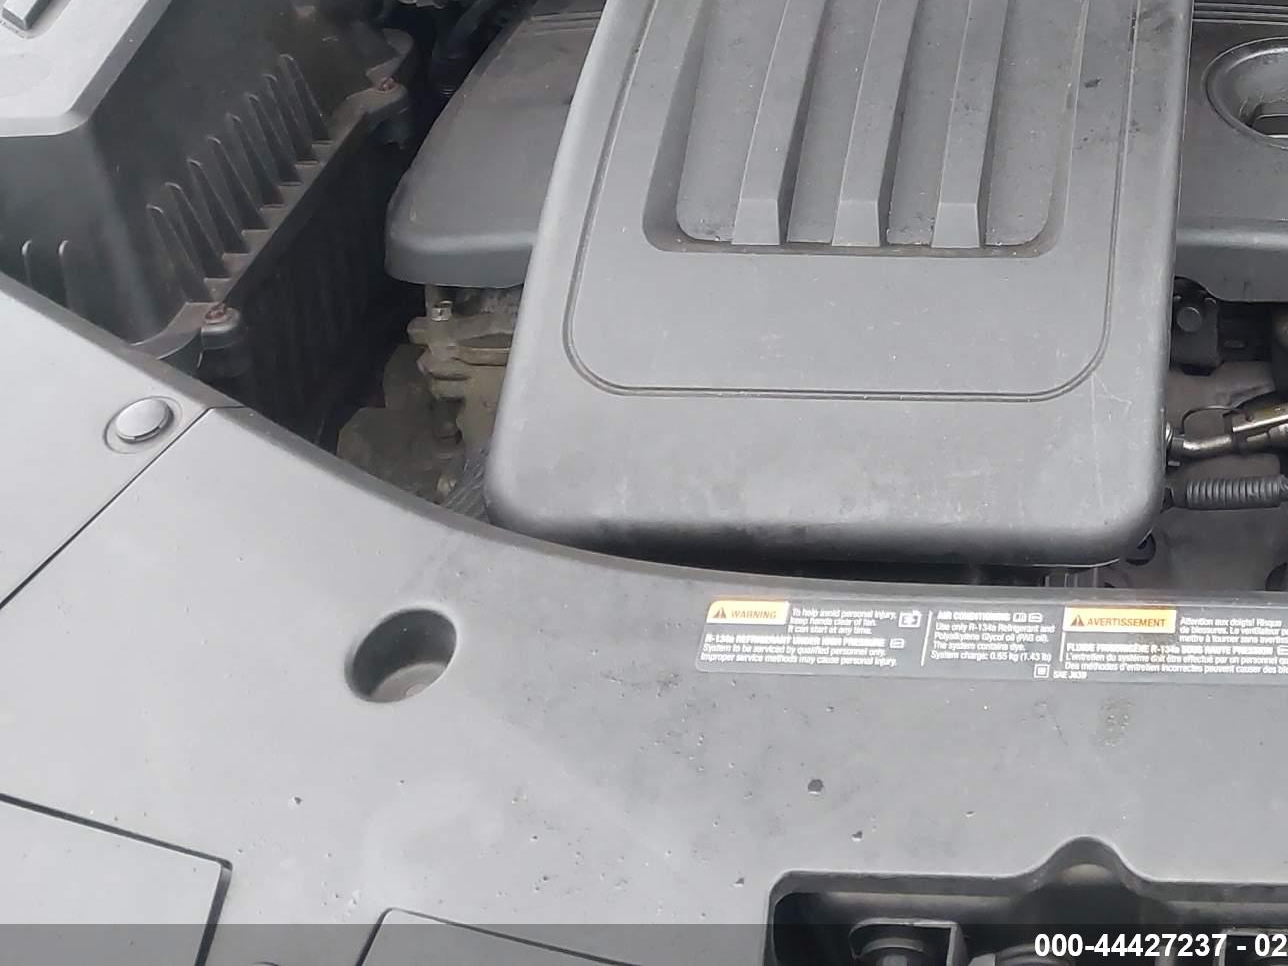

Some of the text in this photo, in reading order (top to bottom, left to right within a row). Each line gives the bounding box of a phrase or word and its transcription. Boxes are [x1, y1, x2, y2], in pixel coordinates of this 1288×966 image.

[731, 610, 777, 619] WARNING
[802, 608, 818, 618] help
[841, 610, 873, 619] personal
[1088, 618, 1167, 627] AVERTISSEMENT
[1180, 617, 1213, 626] Attention
[810, 626, 827, 634] start
[828, 626, 837, 634] at
[838, 627, 852, 636] any
[936, 622, 950, 631] Use
[952, 623, 967, 632] only
[969, 624, 996, 632] R-134a
[1240, 628, 1280, 636] ventilateur
[982, 633, 1004, 642] Glycol
[1006, 634, 1014, 642] oil
[703, 644, 731, 653] System
[786, 646, 794, 656] by
[797, 646, 829, 656] qualified
[830, 648, 868, 656] personnel
[977, 642, 1008, 650] contains
[701, 653, 735, 662] Improper
[736, 654, 763, 662] service
[765, 655, 797, 663] methods
[799, 656, 815, 664] may
[817, 656, 839, 664] cause
[840, 656, 873, 665] personal
[1008, 652, 1019, 662] kg
[1020, 652, 1040, 662] (1.43
[1230, 656, 1239, 664] un
[1241, 656, 1278, 664] personnel
[1162, 664, 1202, 673] incorrectes
[1236, 666, 1261, 674] causer
[1263, 666, 1276, 674] des
